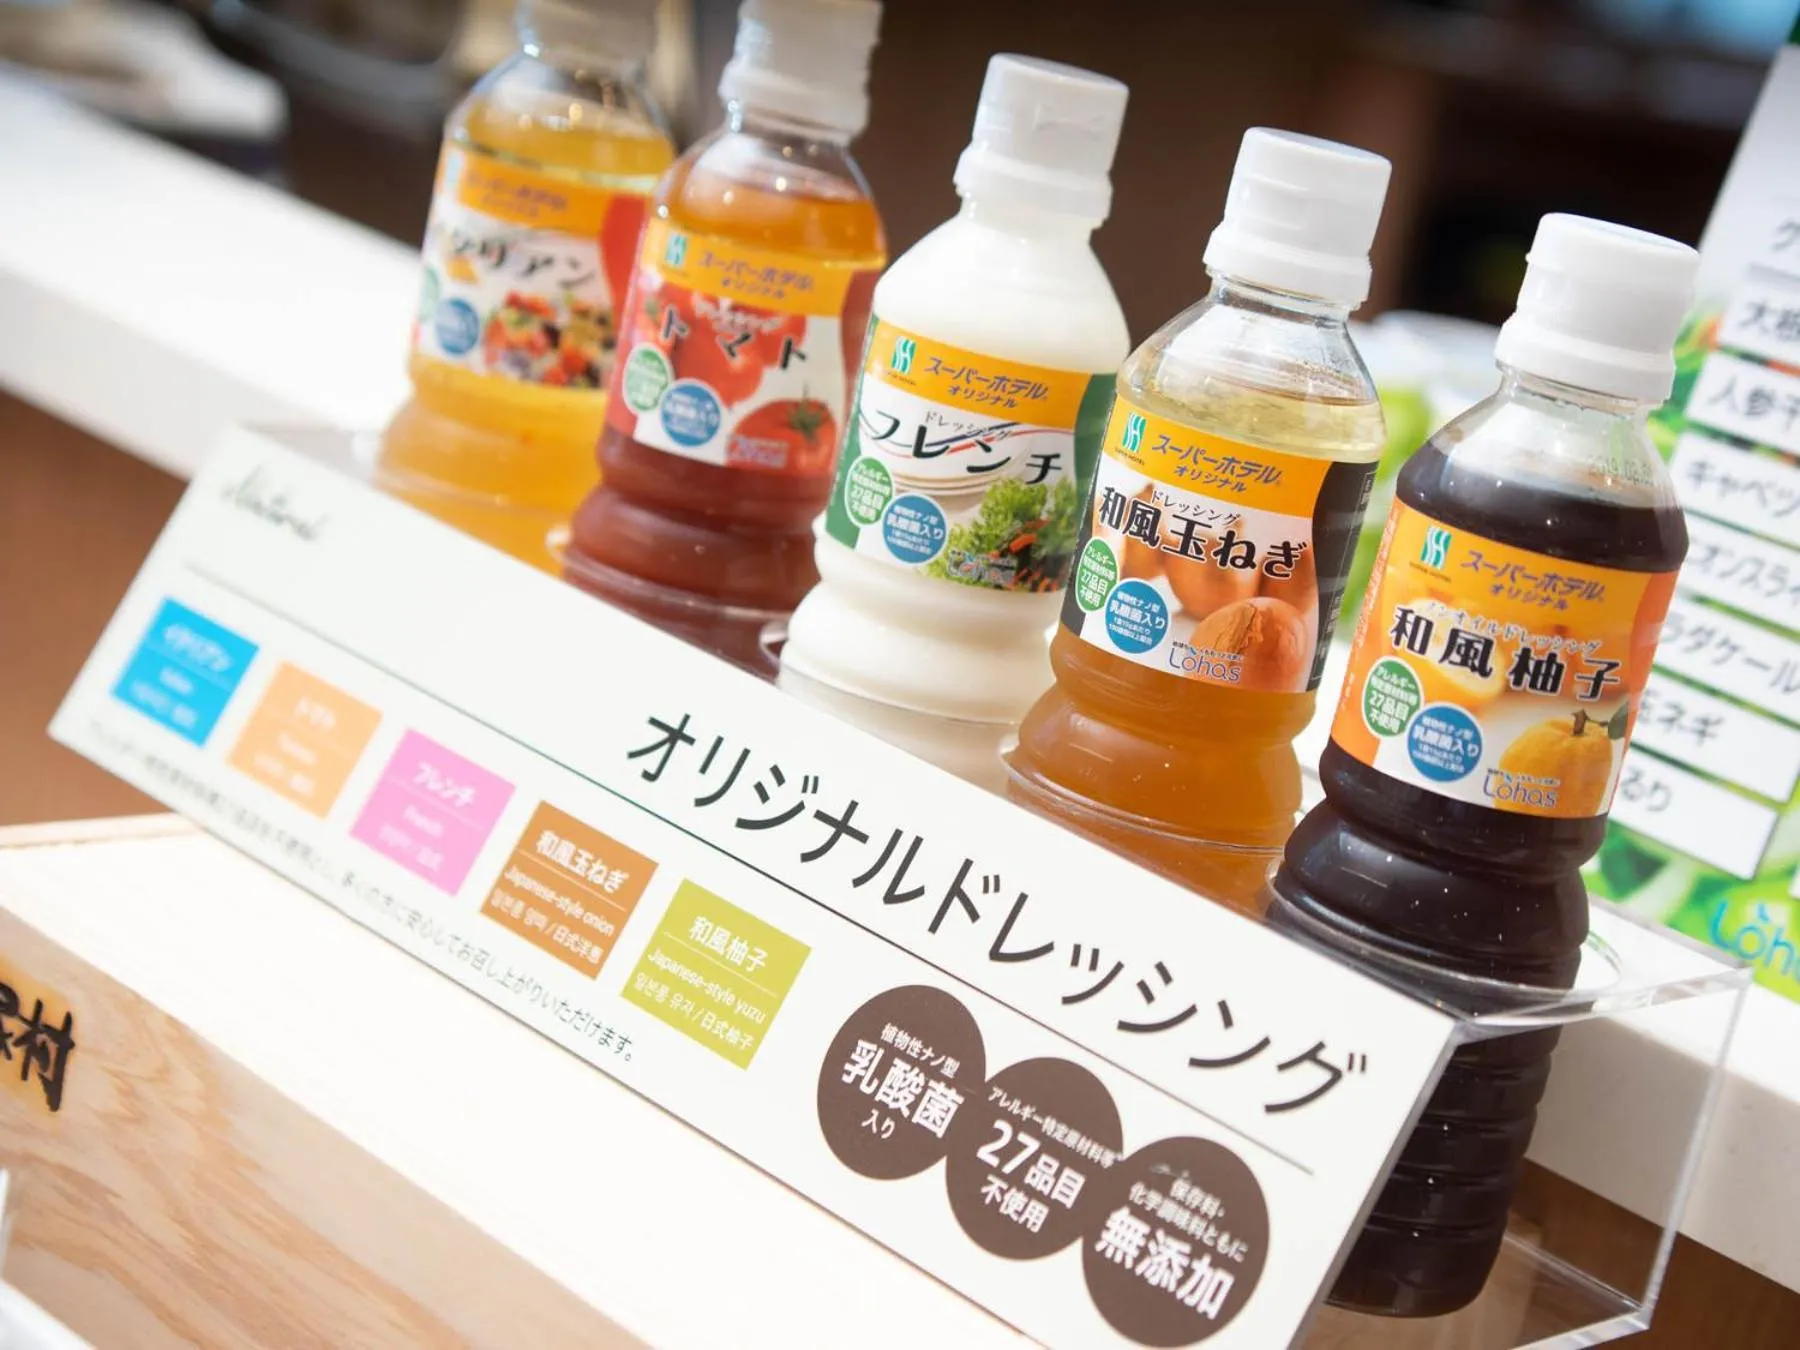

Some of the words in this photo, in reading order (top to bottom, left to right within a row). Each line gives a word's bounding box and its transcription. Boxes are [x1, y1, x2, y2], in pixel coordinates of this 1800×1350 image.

[664, 308, 807, 370] トマト
[924, 357, 1048, 400] スーパーホテル
[948, 385, 1018, 408] オリジナル
[875, 409, 1062, 485] フレンチ
[924, 411, 1013, 441] ドレッシング
[1152, 434, 1281, 484] スーパーホテル
[1174, 465, 1247, 493] オリジナル
[1099, 486, 1308, 578] 和風玉ねぎ
[1151, 490, 1241, 526] ドレッシング
[1460, 550, 1605, 601] スーパーホテル
[1490, 585, 1569, 611] オリジナル
[1391, 606, 1621, 701] 和風柚子
[413, 761, 477, 808] フレンチ
[537, 830, 629, 893] 和風玉ねぎ
[627, 712, 1368, 1114] オリジナルドレッシング
[689, 915, 768, 973] 和風柚子
[1710, 902, 1800, 987] Loh
[648, 947, 736, 1006] Japanese-style
[736, 996, 766, 1025] yuzu
[881, 1022, 961, 1079] 植物性ナノ型
[841, 1039, 965, 1138] 乳酸菌
[861, 1108, 896, 1140] 入り
[976, 1119, 1086, 1210] 27品目
[980, 1173, 1050, 1234] 不使用
[1095, 1205, 1236, 1321] 無添加
